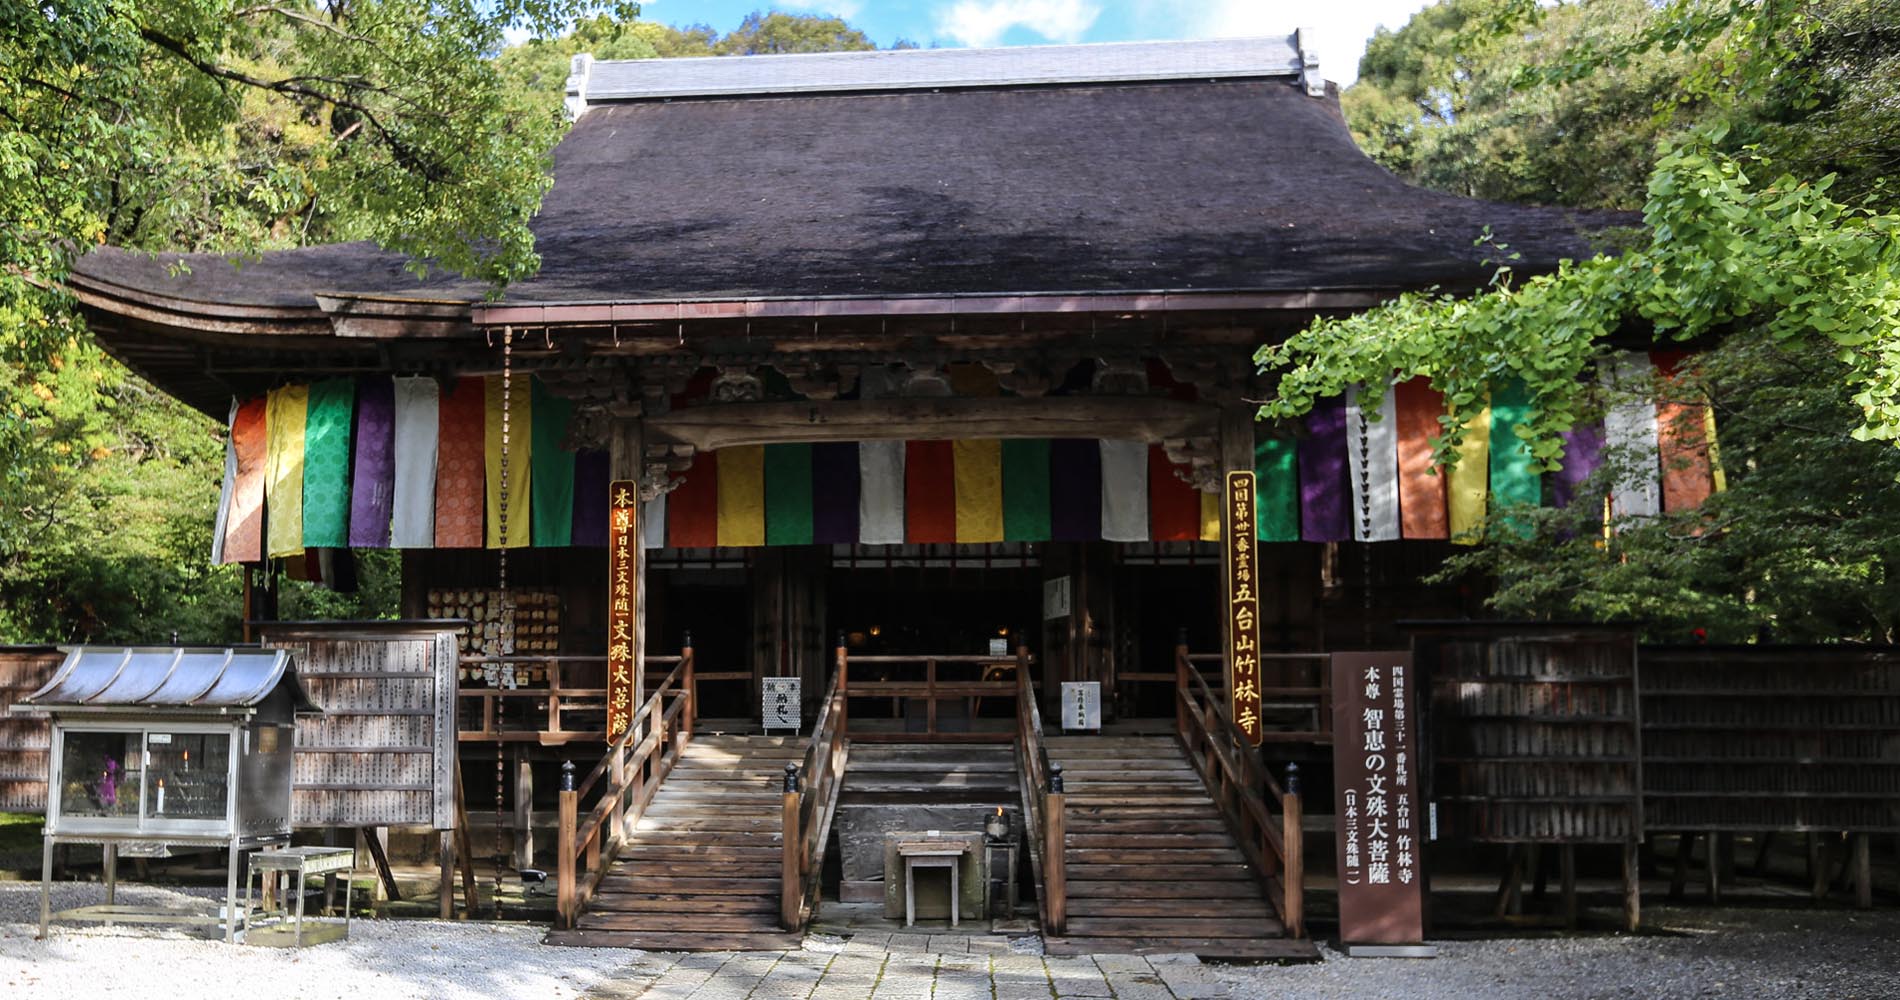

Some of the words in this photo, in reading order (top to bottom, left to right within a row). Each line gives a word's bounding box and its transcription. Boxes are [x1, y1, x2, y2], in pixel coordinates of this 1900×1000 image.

[1364, 666, 1381, 700] 本尊
[1392, 666, 1408, 786] 四国霊場第三十一番札所
[1363, 707, 1390, 885] 智恵の文殊大菩薩
[1397, 793, 1410, 829] 五台山
[1396, 834, 1413, 884] 竹林寺
